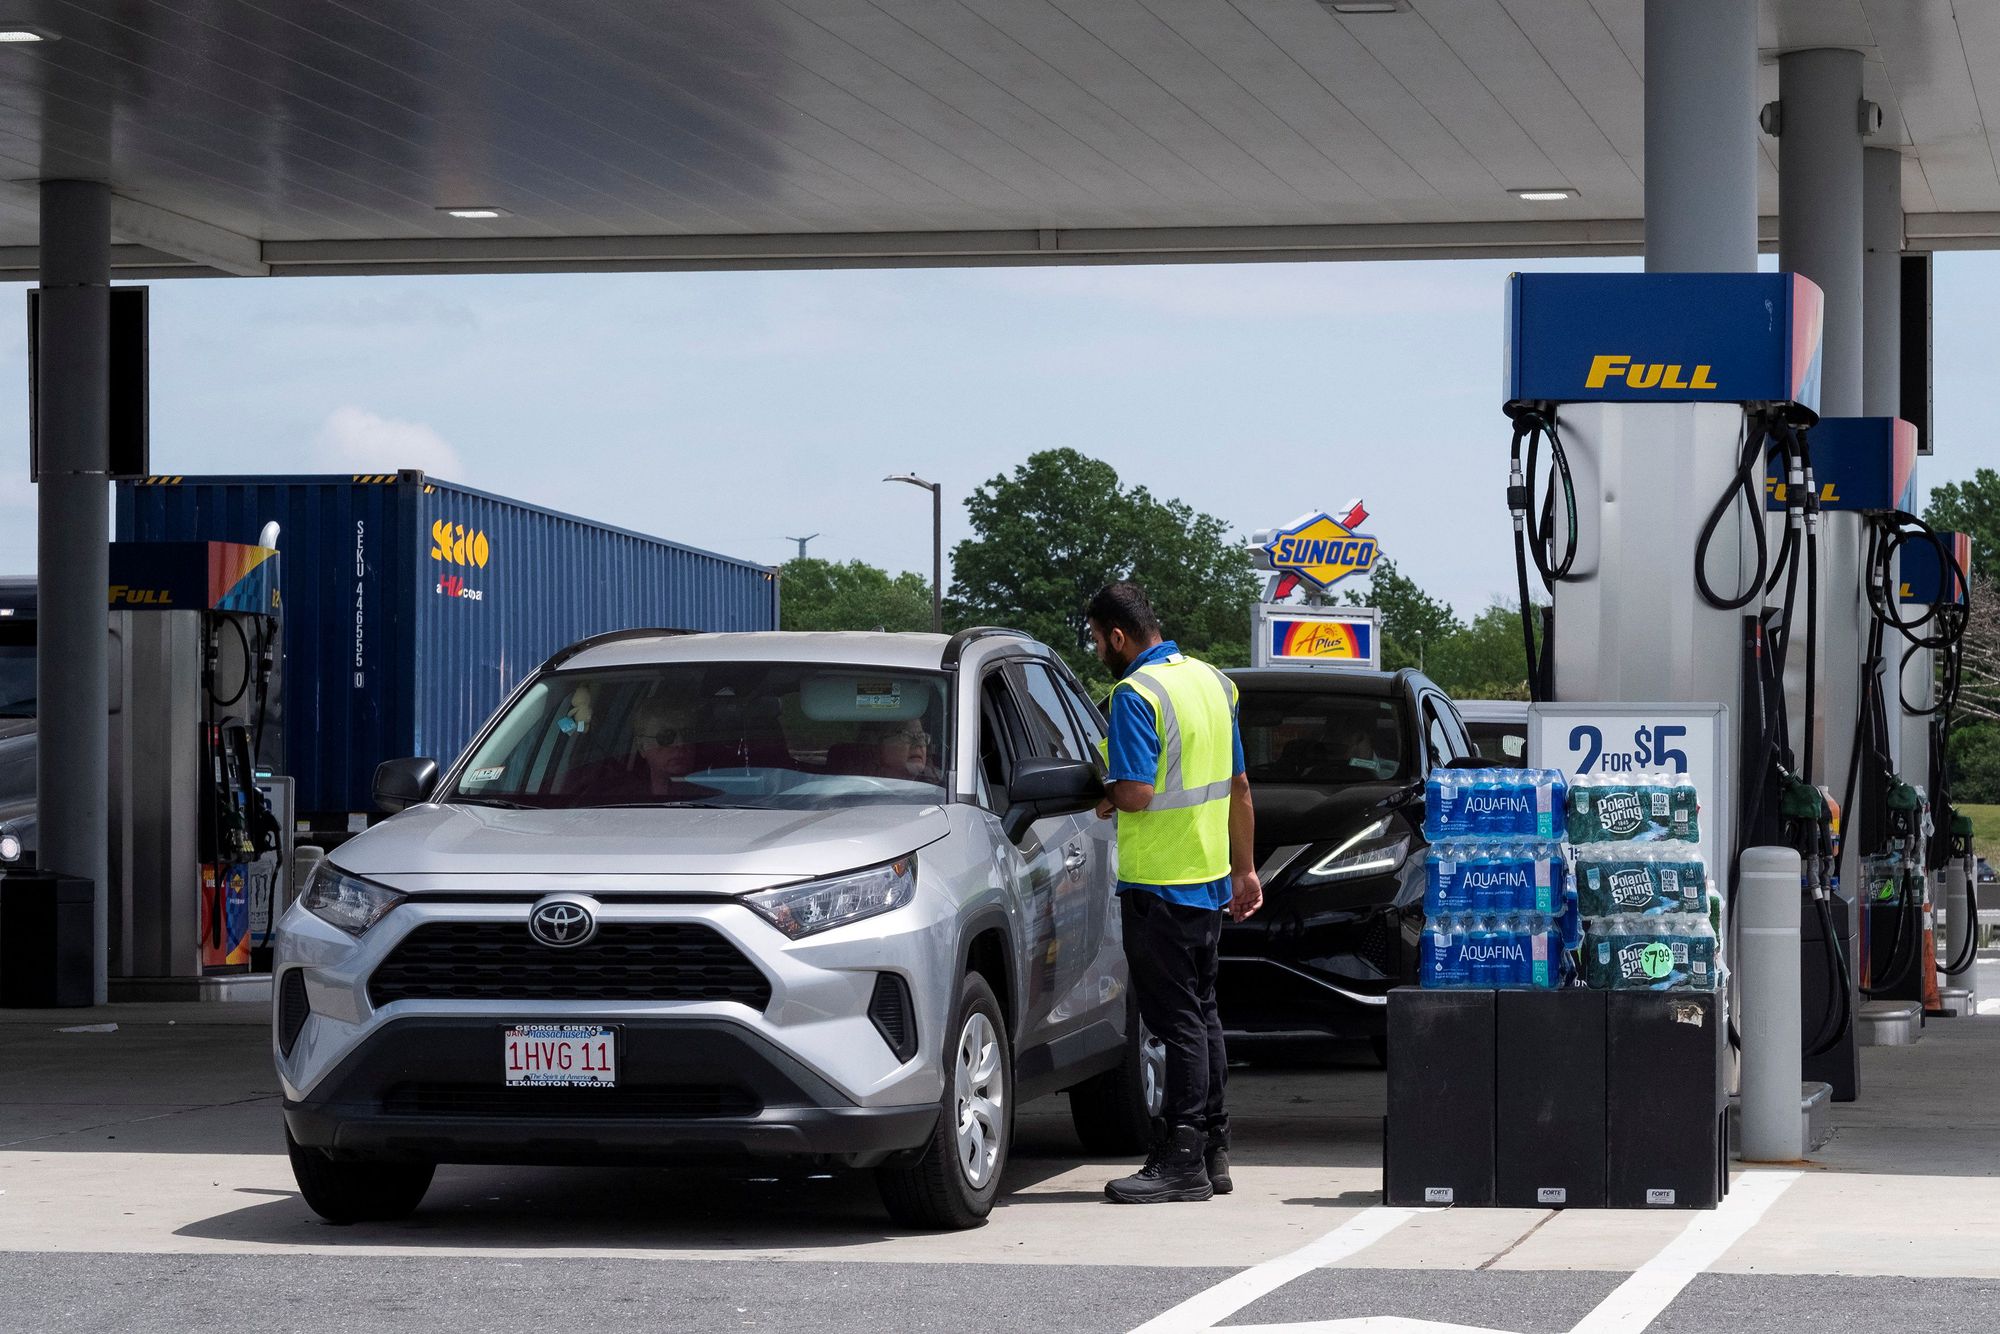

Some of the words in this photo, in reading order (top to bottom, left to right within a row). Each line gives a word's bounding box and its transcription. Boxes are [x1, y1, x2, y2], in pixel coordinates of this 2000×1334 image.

[1584, 355, 1718, 390] FULL
[356, 520, 364, 577] SEKU
[1277, 538, 1374, 566] SUNOCO
[108, 585, 173, 604] FULL
[356, 582, 364, 667] 446555
[1569, 725, 1602, 774] 2
[1602, 753, 1632, 772] FOR
[1635, 725, 1687, 774] $5
[1464, 796, 1530, 814] AQUAFINA
[1597, 791, 1641, 815] Poland
[1600, 806, 1644, 829] Spring
[1462, 870, 1528, 889] AQUAFINA
[1608, 868, 1651, 890] Poland
[1611, 882, 1654, 903] Spring
[1459, 944, 1525, 962] AQUAFINA
[1618, 948, 1645, 964] Pola
[528, 1031, 592, 1039] Massachusetts
[509, 1042, 572, 1070] 1HVG
[581, 1042, 611, 1071] 11
